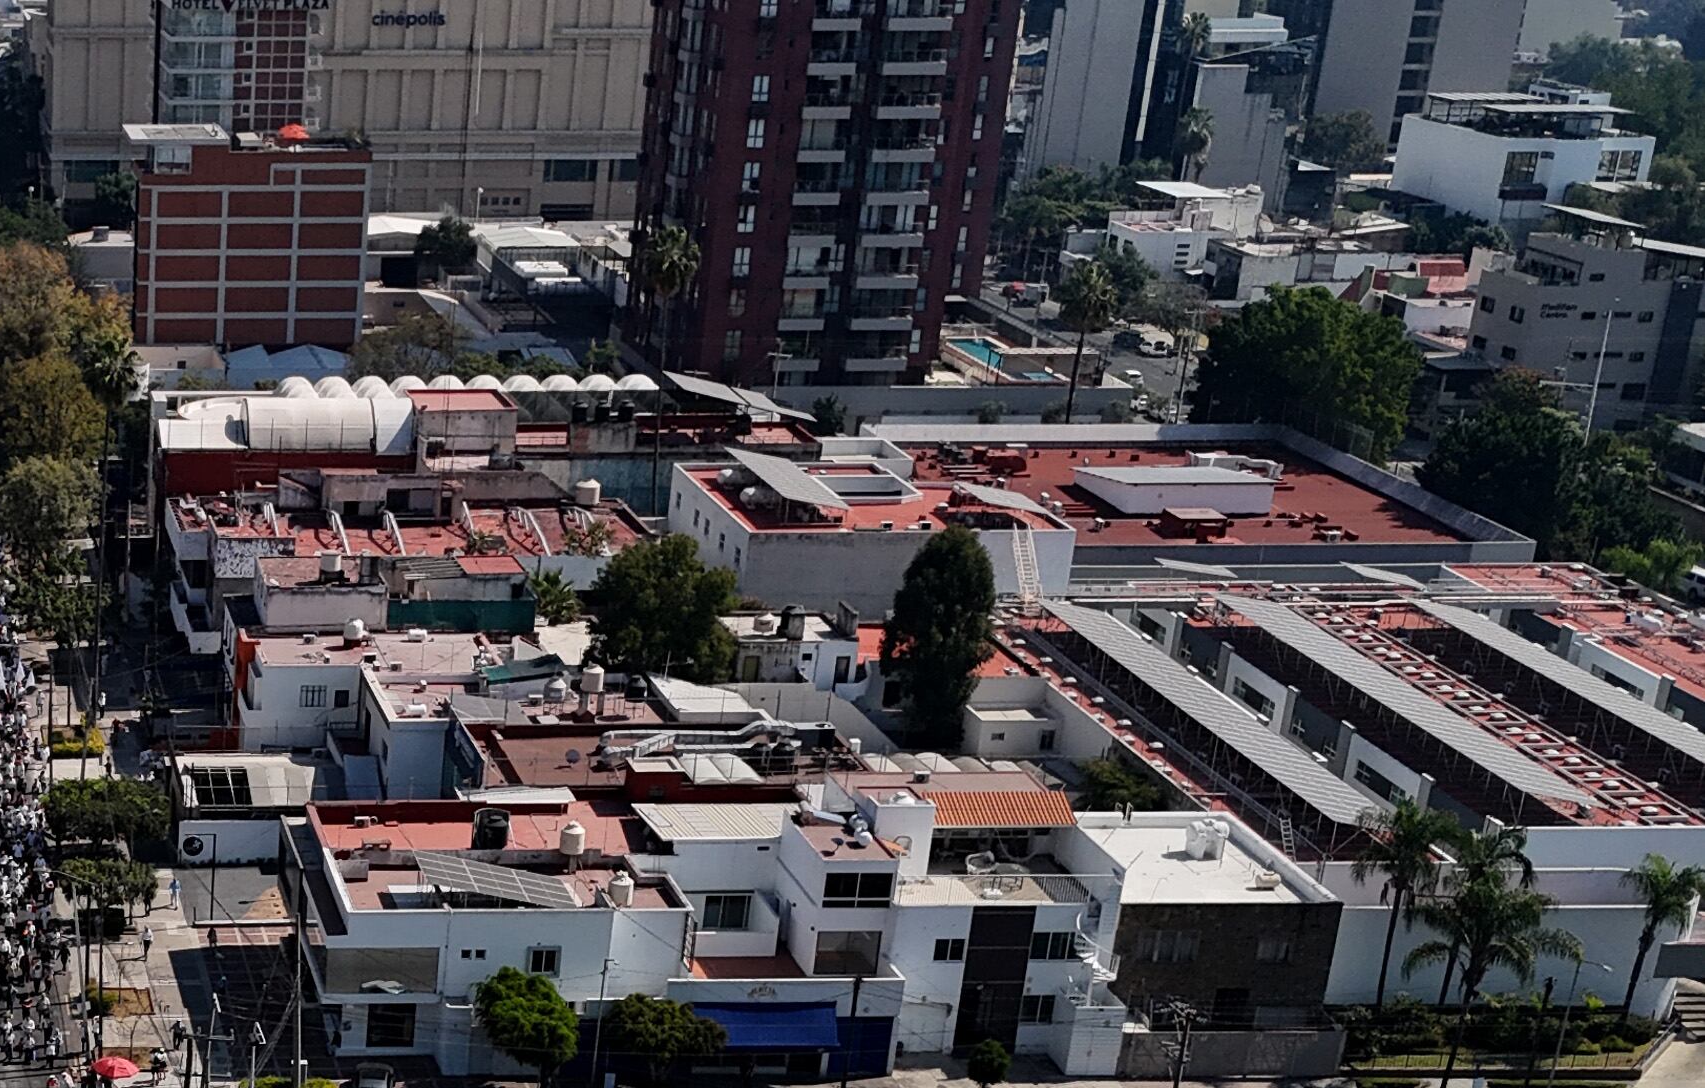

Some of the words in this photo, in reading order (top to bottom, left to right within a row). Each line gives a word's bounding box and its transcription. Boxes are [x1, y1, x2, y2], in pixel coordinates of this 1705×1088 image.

[172, 0, 219, 9] HOTEL
[284, 0, 329, 9] PLAZA
[372, 10, 445, 29] cinépolis
